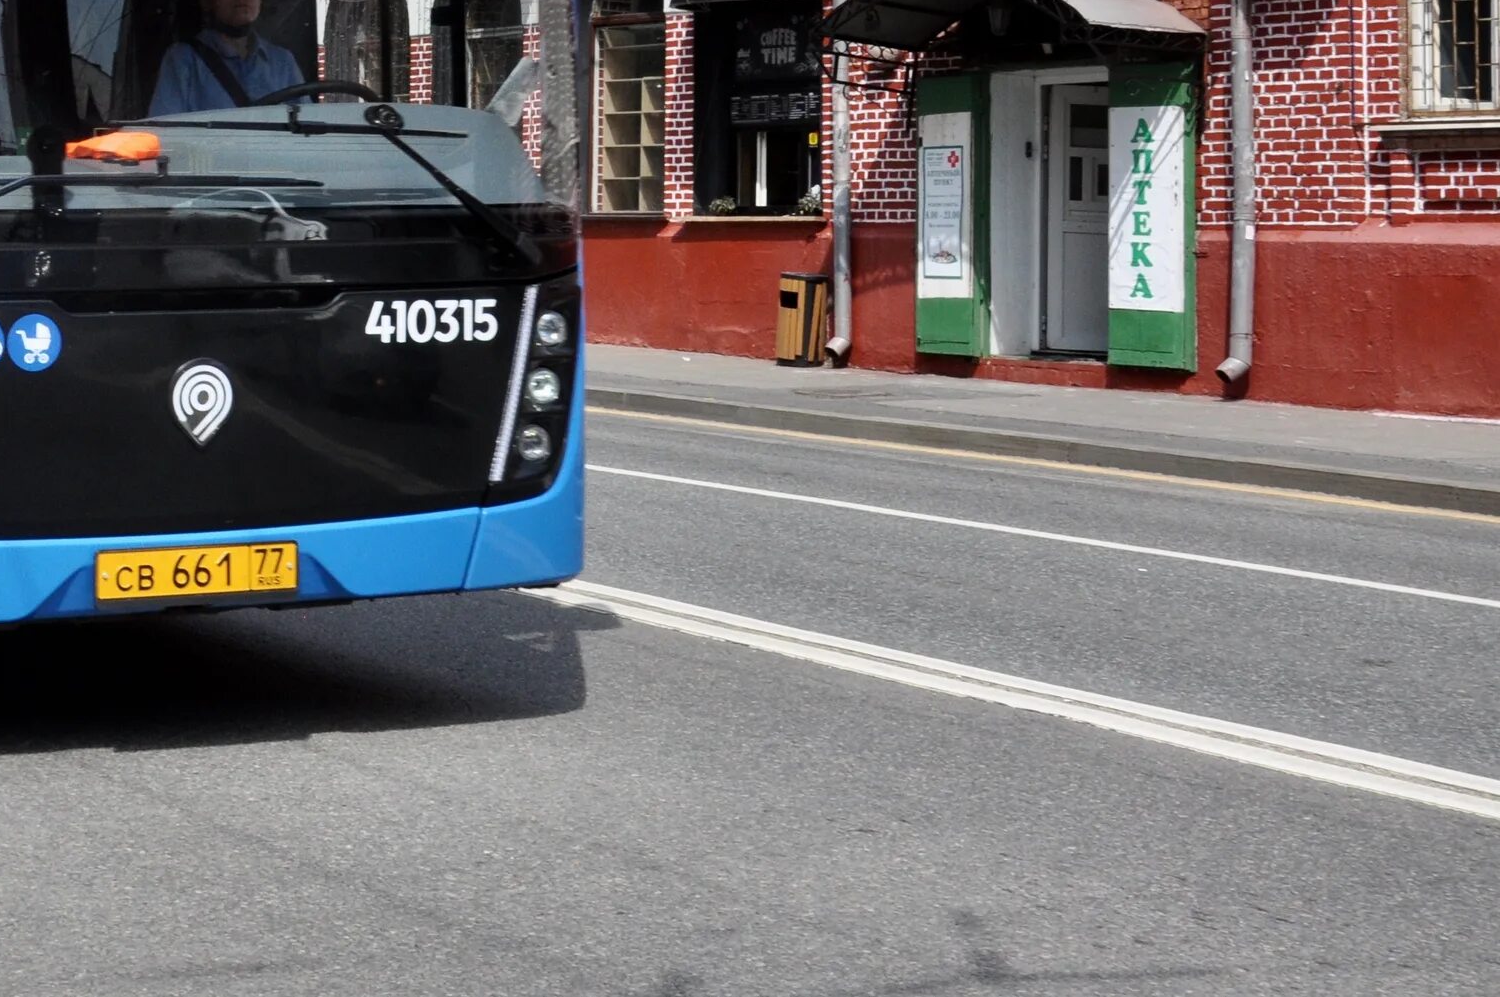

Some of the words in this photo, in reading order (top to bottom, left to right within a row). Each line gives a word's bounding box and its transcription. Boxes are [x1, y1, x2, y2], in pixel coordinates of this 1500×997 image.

[760, 28, 797, 46] COFFEE
[761, 46, 797, 65] TIME
[1129, 118, 1153, 299] АПТЕКА
[364, 298, 499, 344] 410315
[115, 564, 155, 592] СВ
[172, 553, 232, 589] 661
[253, 547, 284, 575] 77
[258, 575, 282, 586] RUS
